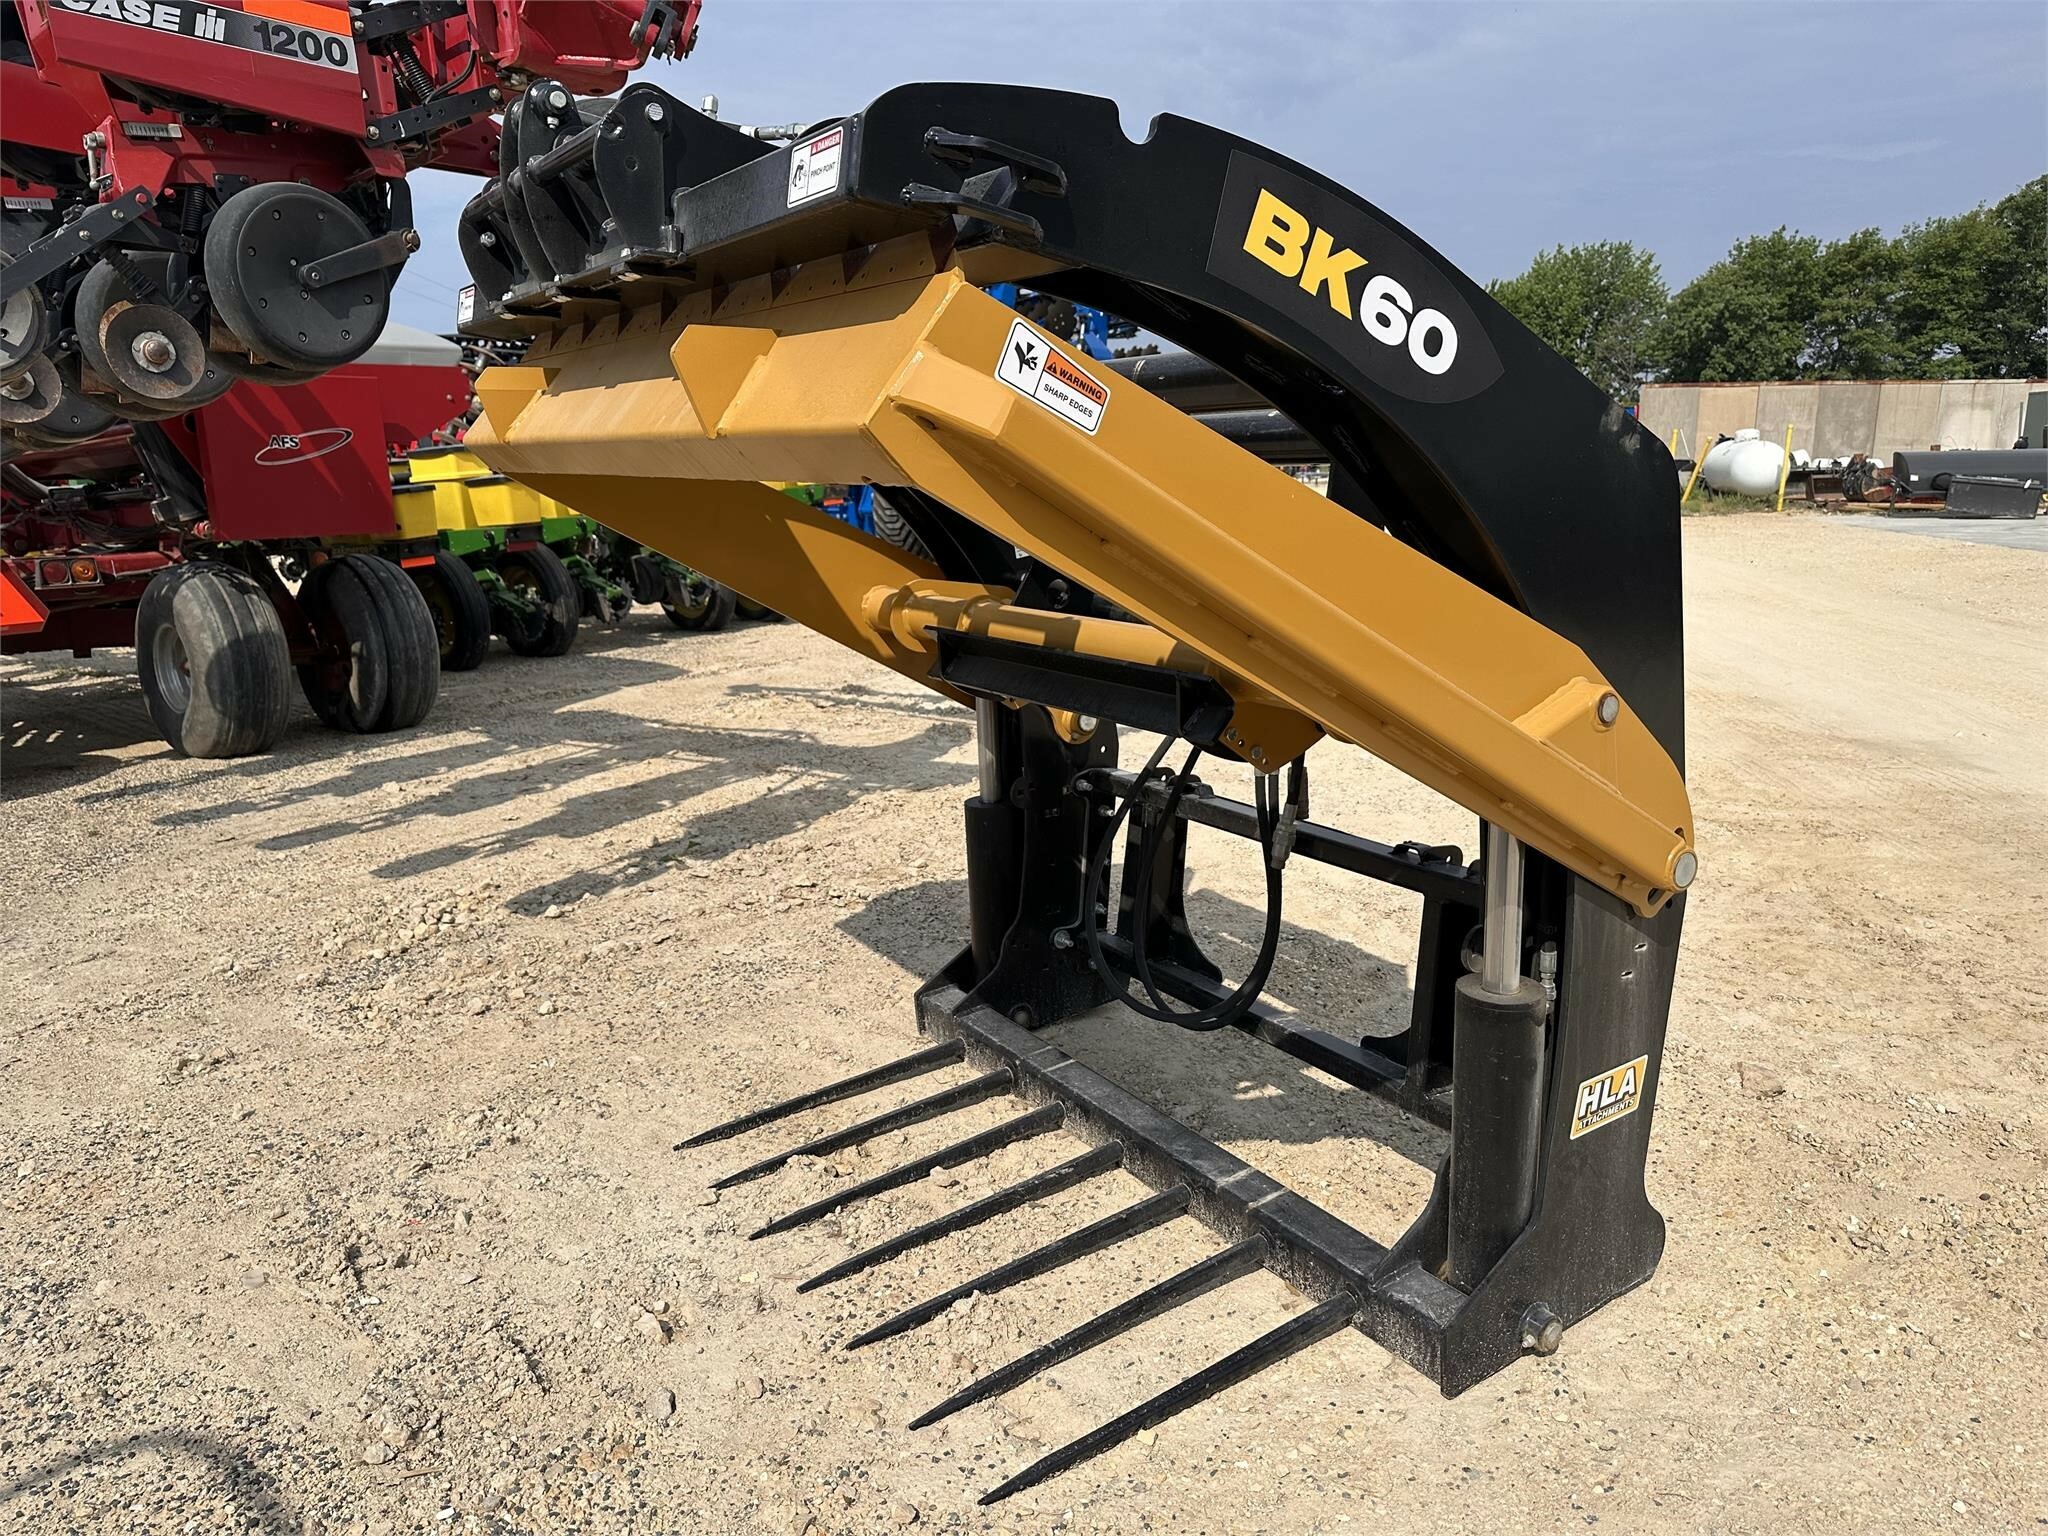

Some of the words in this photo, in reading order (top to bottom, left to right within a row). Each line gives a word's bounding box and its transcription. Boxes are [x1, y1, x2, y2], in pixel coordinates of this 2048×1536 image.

[253, 21, 349, 67] 1200
[817, 132, 841, 150] DANGER
[1043, 383, 1069, 402] SHARP
[1068, 399, 1094, 418] EDGES
[1060, 367, 1103, 400] WARNING
[269, 435, 300, 449] AFS
[1578, 1066, 1637, 1119] HLA
[1576, 1097, 1636, 1131] ATTACHMENTS
